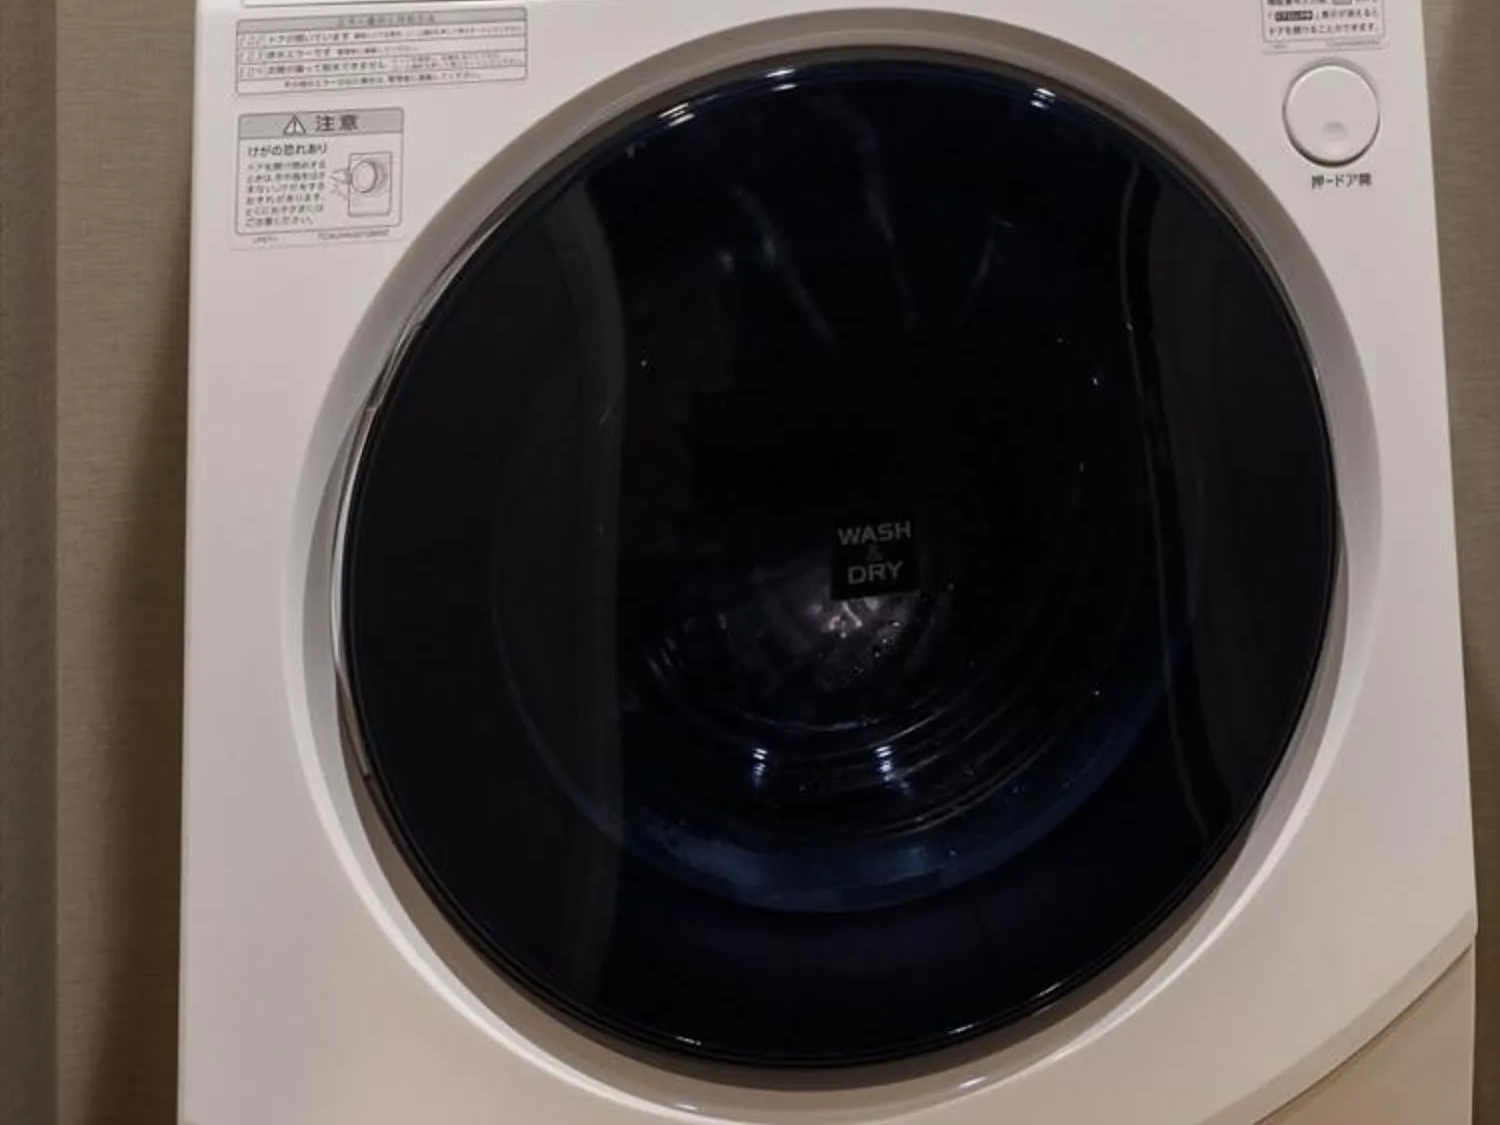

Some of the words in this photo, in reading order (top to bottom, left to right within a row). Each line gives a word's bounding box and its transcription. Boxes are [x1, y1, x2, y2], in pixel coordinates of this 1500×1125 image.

[315, 114, 359, 133] 注意
[837, 520, 912, 546] WASH
[848, 560, 904, 585] DRY
